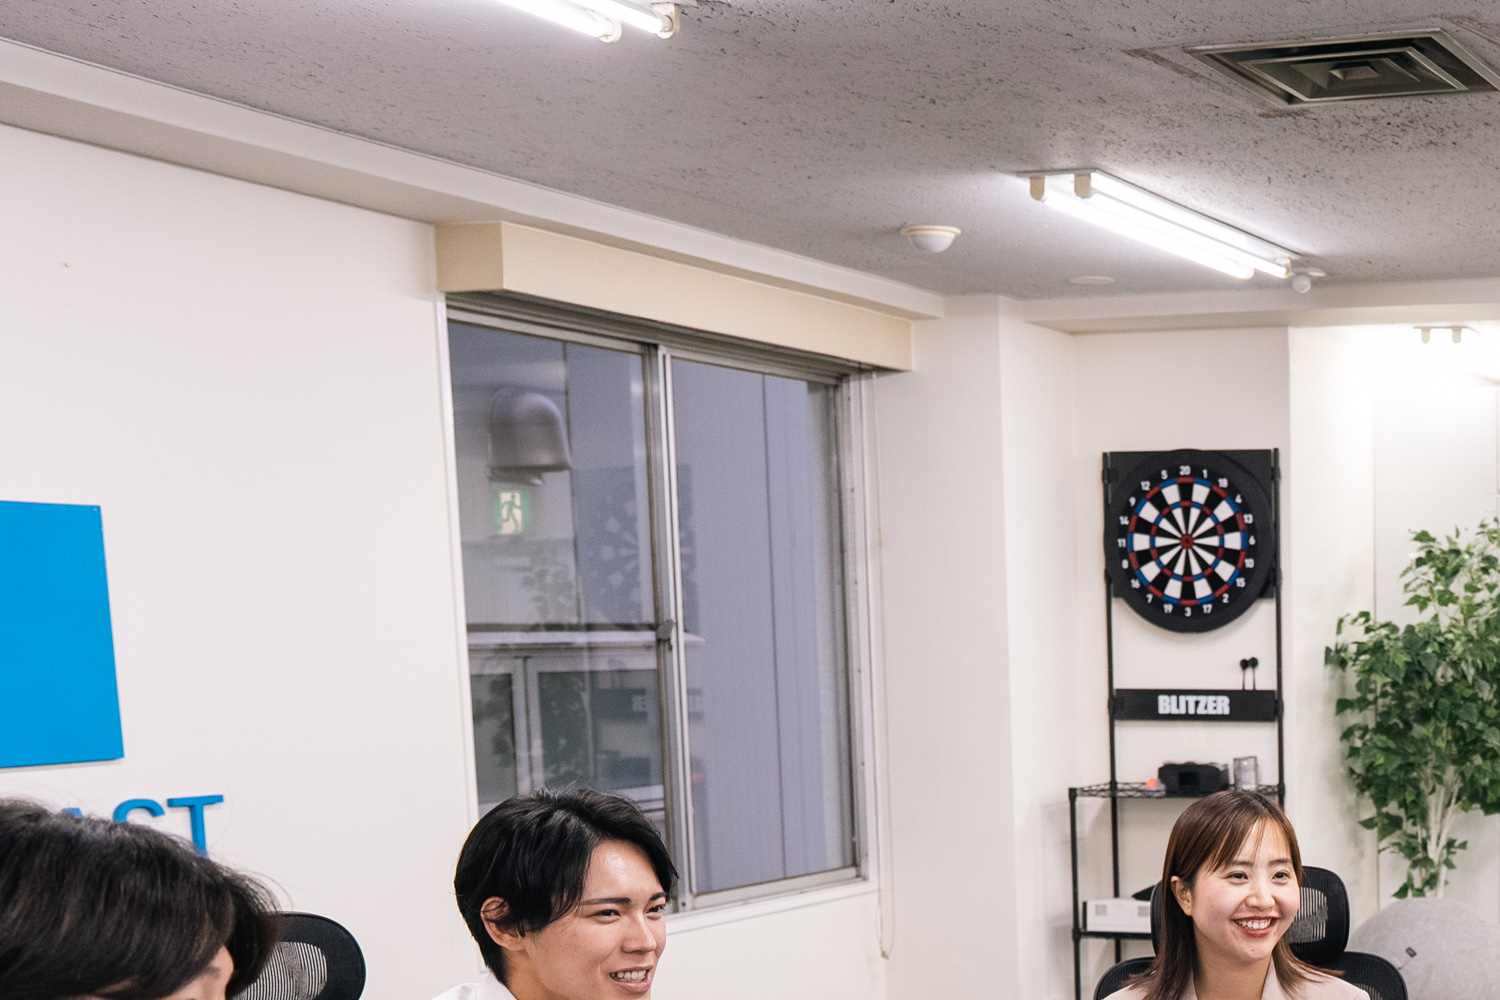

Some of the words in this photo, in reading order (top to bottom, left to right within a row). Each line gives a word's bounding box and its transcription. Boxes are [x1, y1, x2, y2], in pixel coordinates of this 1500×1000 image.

[1161, 469, 1168, 480] 5
[1179, 465, 1191, 476] 20
[1202, 469, 1208, 479] 1
[1140, 481, 1150, 491] 12
[1218, 478, 1228, 488] 18
[1129, 496, 1136, 507] 9
[1235, 494, 1242, 504] 4
[1119, 516, 1129, 525] 14
[1243, 513, 1253, 524] 13
[1117, 538, 1126, 548] 11
[1248, 535, 1256, 546] 6
[1122, 559, 1129, 570] 8
[1245, 558, 1255, 569] 10
[1131, 579, 1140, 589] 16
[1236, 578, 1246, 588] 15
[1146, 593, 1153, 604] 7
[1222, 593, 1229, 604] 2
[1163, 604, 1173, 614] 19
[1184, 607, 1192, 617] 3
[1203, 604, 1213, 614] 17
[1157, 694, 1230, 715] BLITZER
